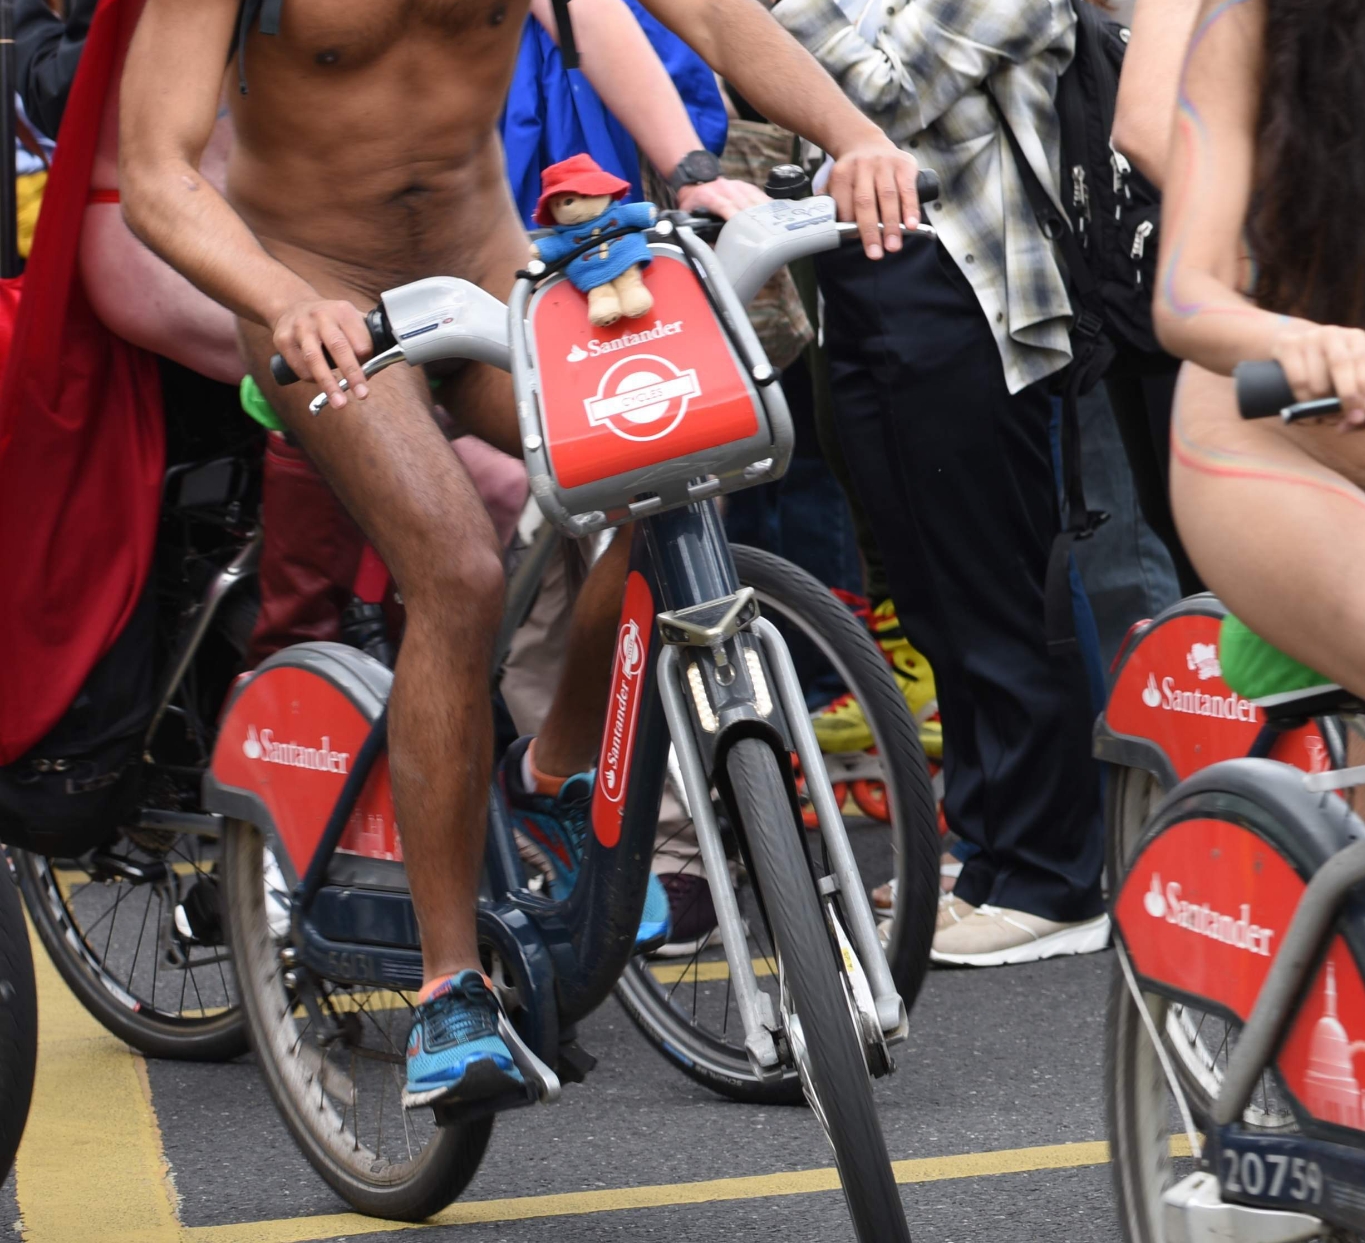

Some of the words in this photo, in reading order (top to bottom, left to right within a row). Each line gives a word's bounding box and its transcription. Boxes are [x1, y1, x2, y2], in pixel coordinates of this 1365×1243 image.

[587, 320, 684, 357] Santander
[607, 679, 630, 770] Santander
[1161, 676, 1258, 723] Santander
[260, 728, 349, 774] Santander
[1165, 881, 1275, 957] Santander
[1225, 1149, 1323, 1204] 20759
